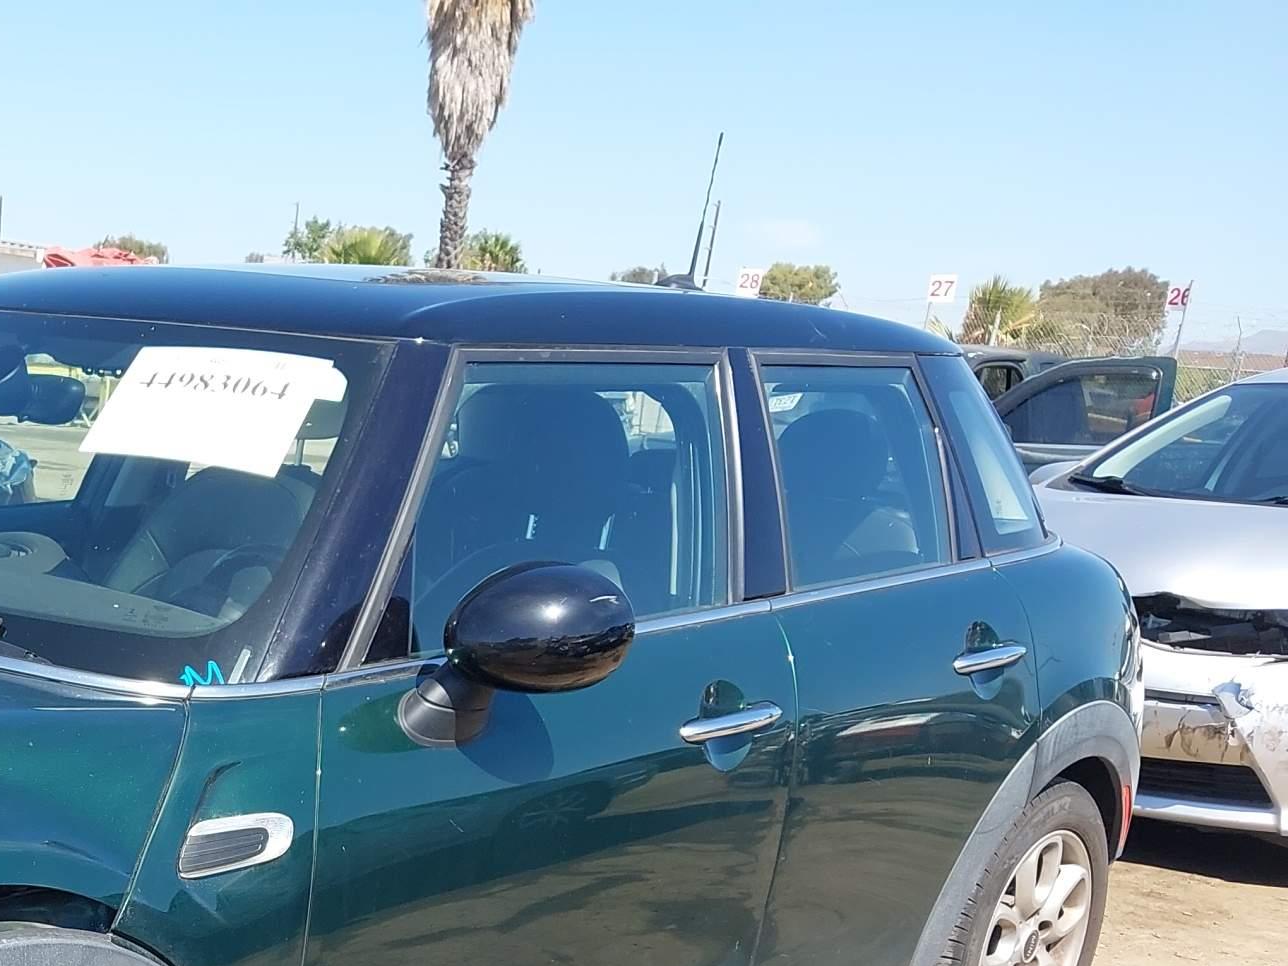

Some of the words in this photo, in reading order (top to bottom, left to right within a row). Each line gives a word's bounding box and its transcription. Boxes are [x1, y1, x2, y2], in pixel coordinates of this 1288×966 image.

[739, 273, 760, 289] 28
[929, 280, 955, 297] 27
[1168, 287, 1190, 306] 26
[139, 370, 291, 400] 44983064
